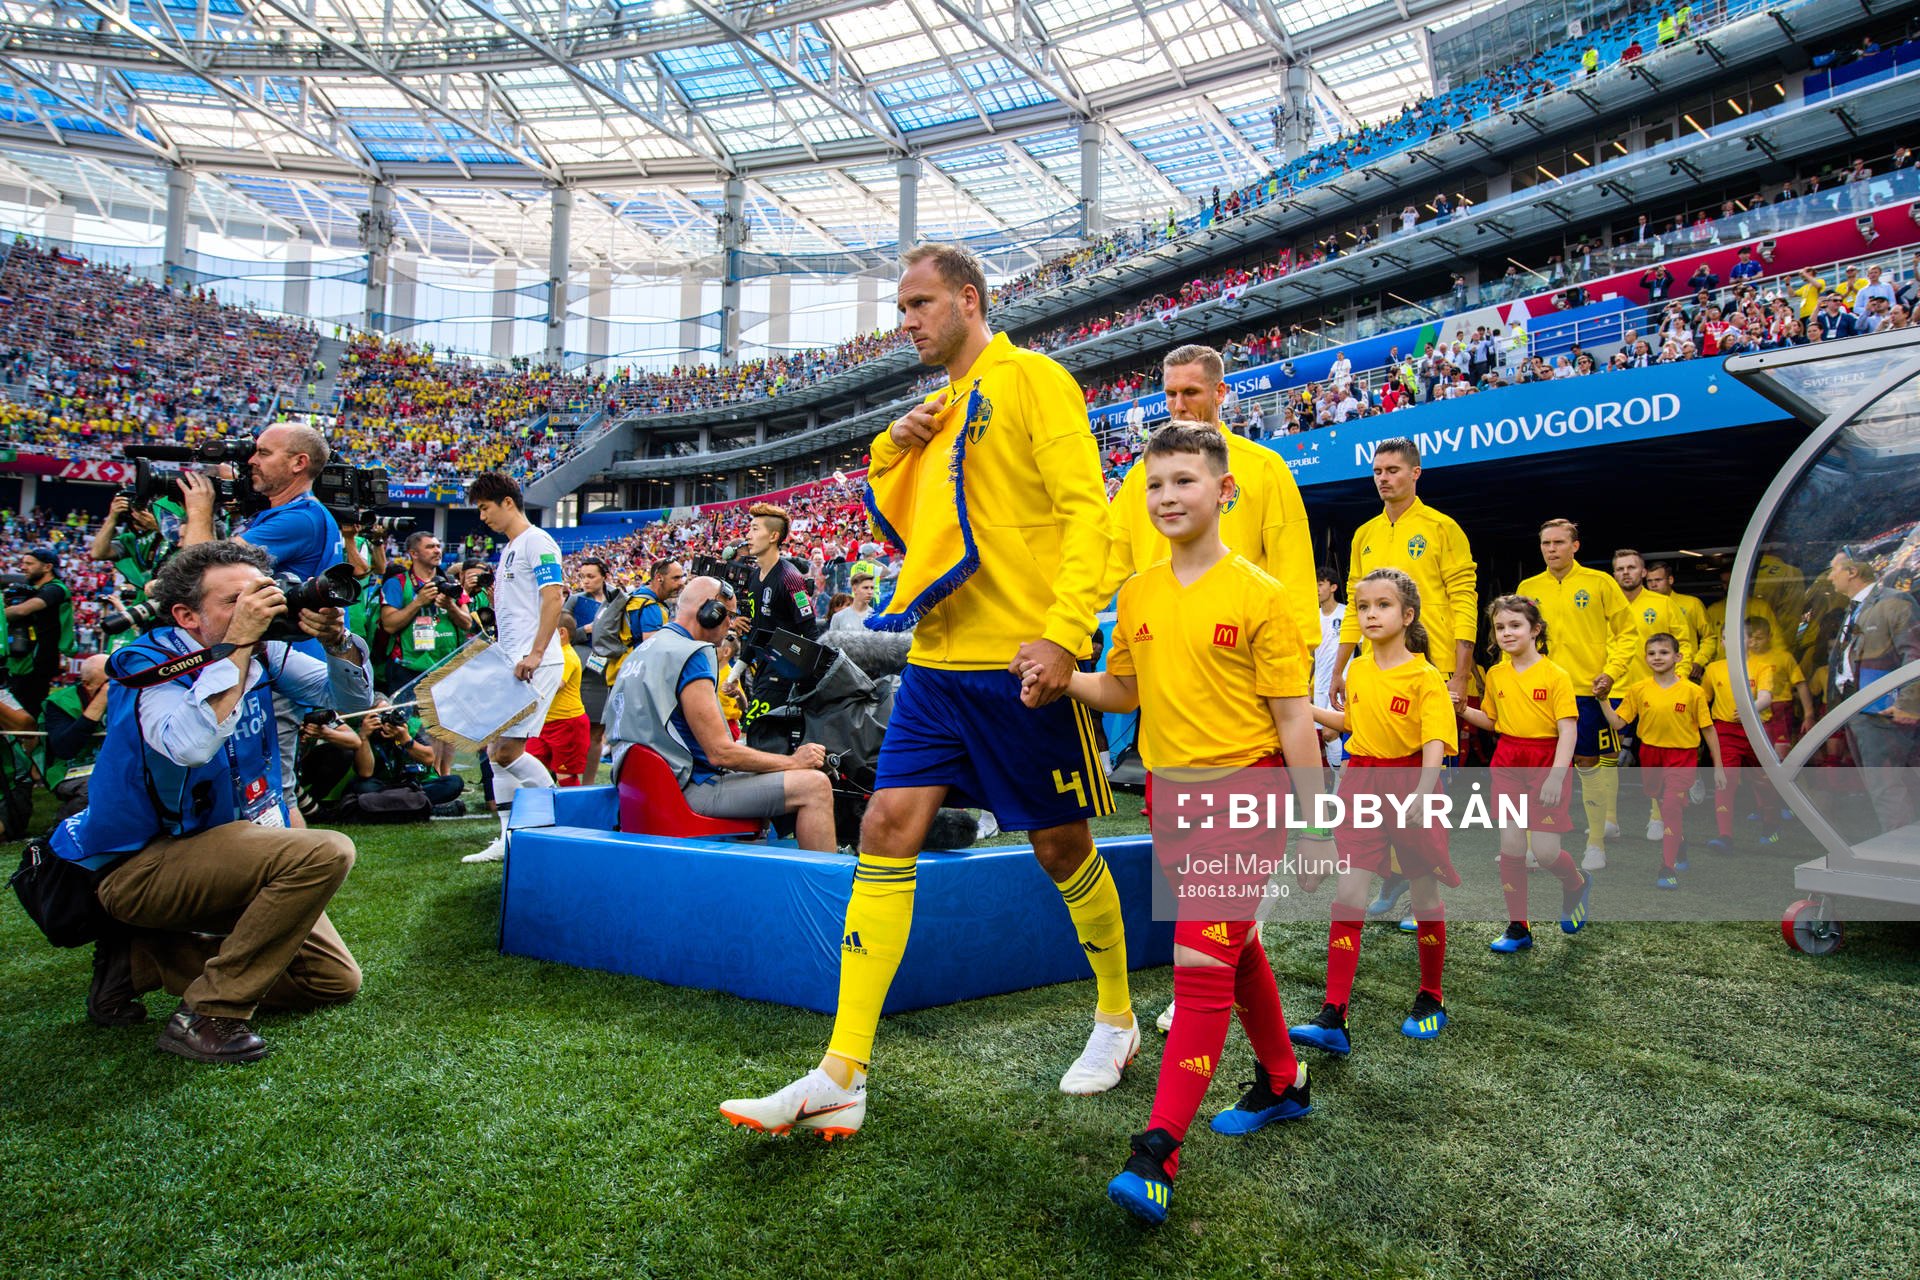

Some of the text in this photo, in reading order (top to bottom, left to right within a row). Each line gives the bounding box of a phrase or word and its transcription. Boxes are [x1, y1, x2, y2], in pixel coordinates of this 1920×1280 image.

[1470, 393, 1681, 449] NOVGOROD
[1133, 633, 1154, 643] adidas
[158, 655, 204, 676] Canon
[745, 699, 771, 719] 23
[1599, 728, 1611, 750] 6
[1052, 769, 1088, 808] 4
[1202, 929, 1230, 946] adidas
[1179, 1061, 1211, 1079] adidas
